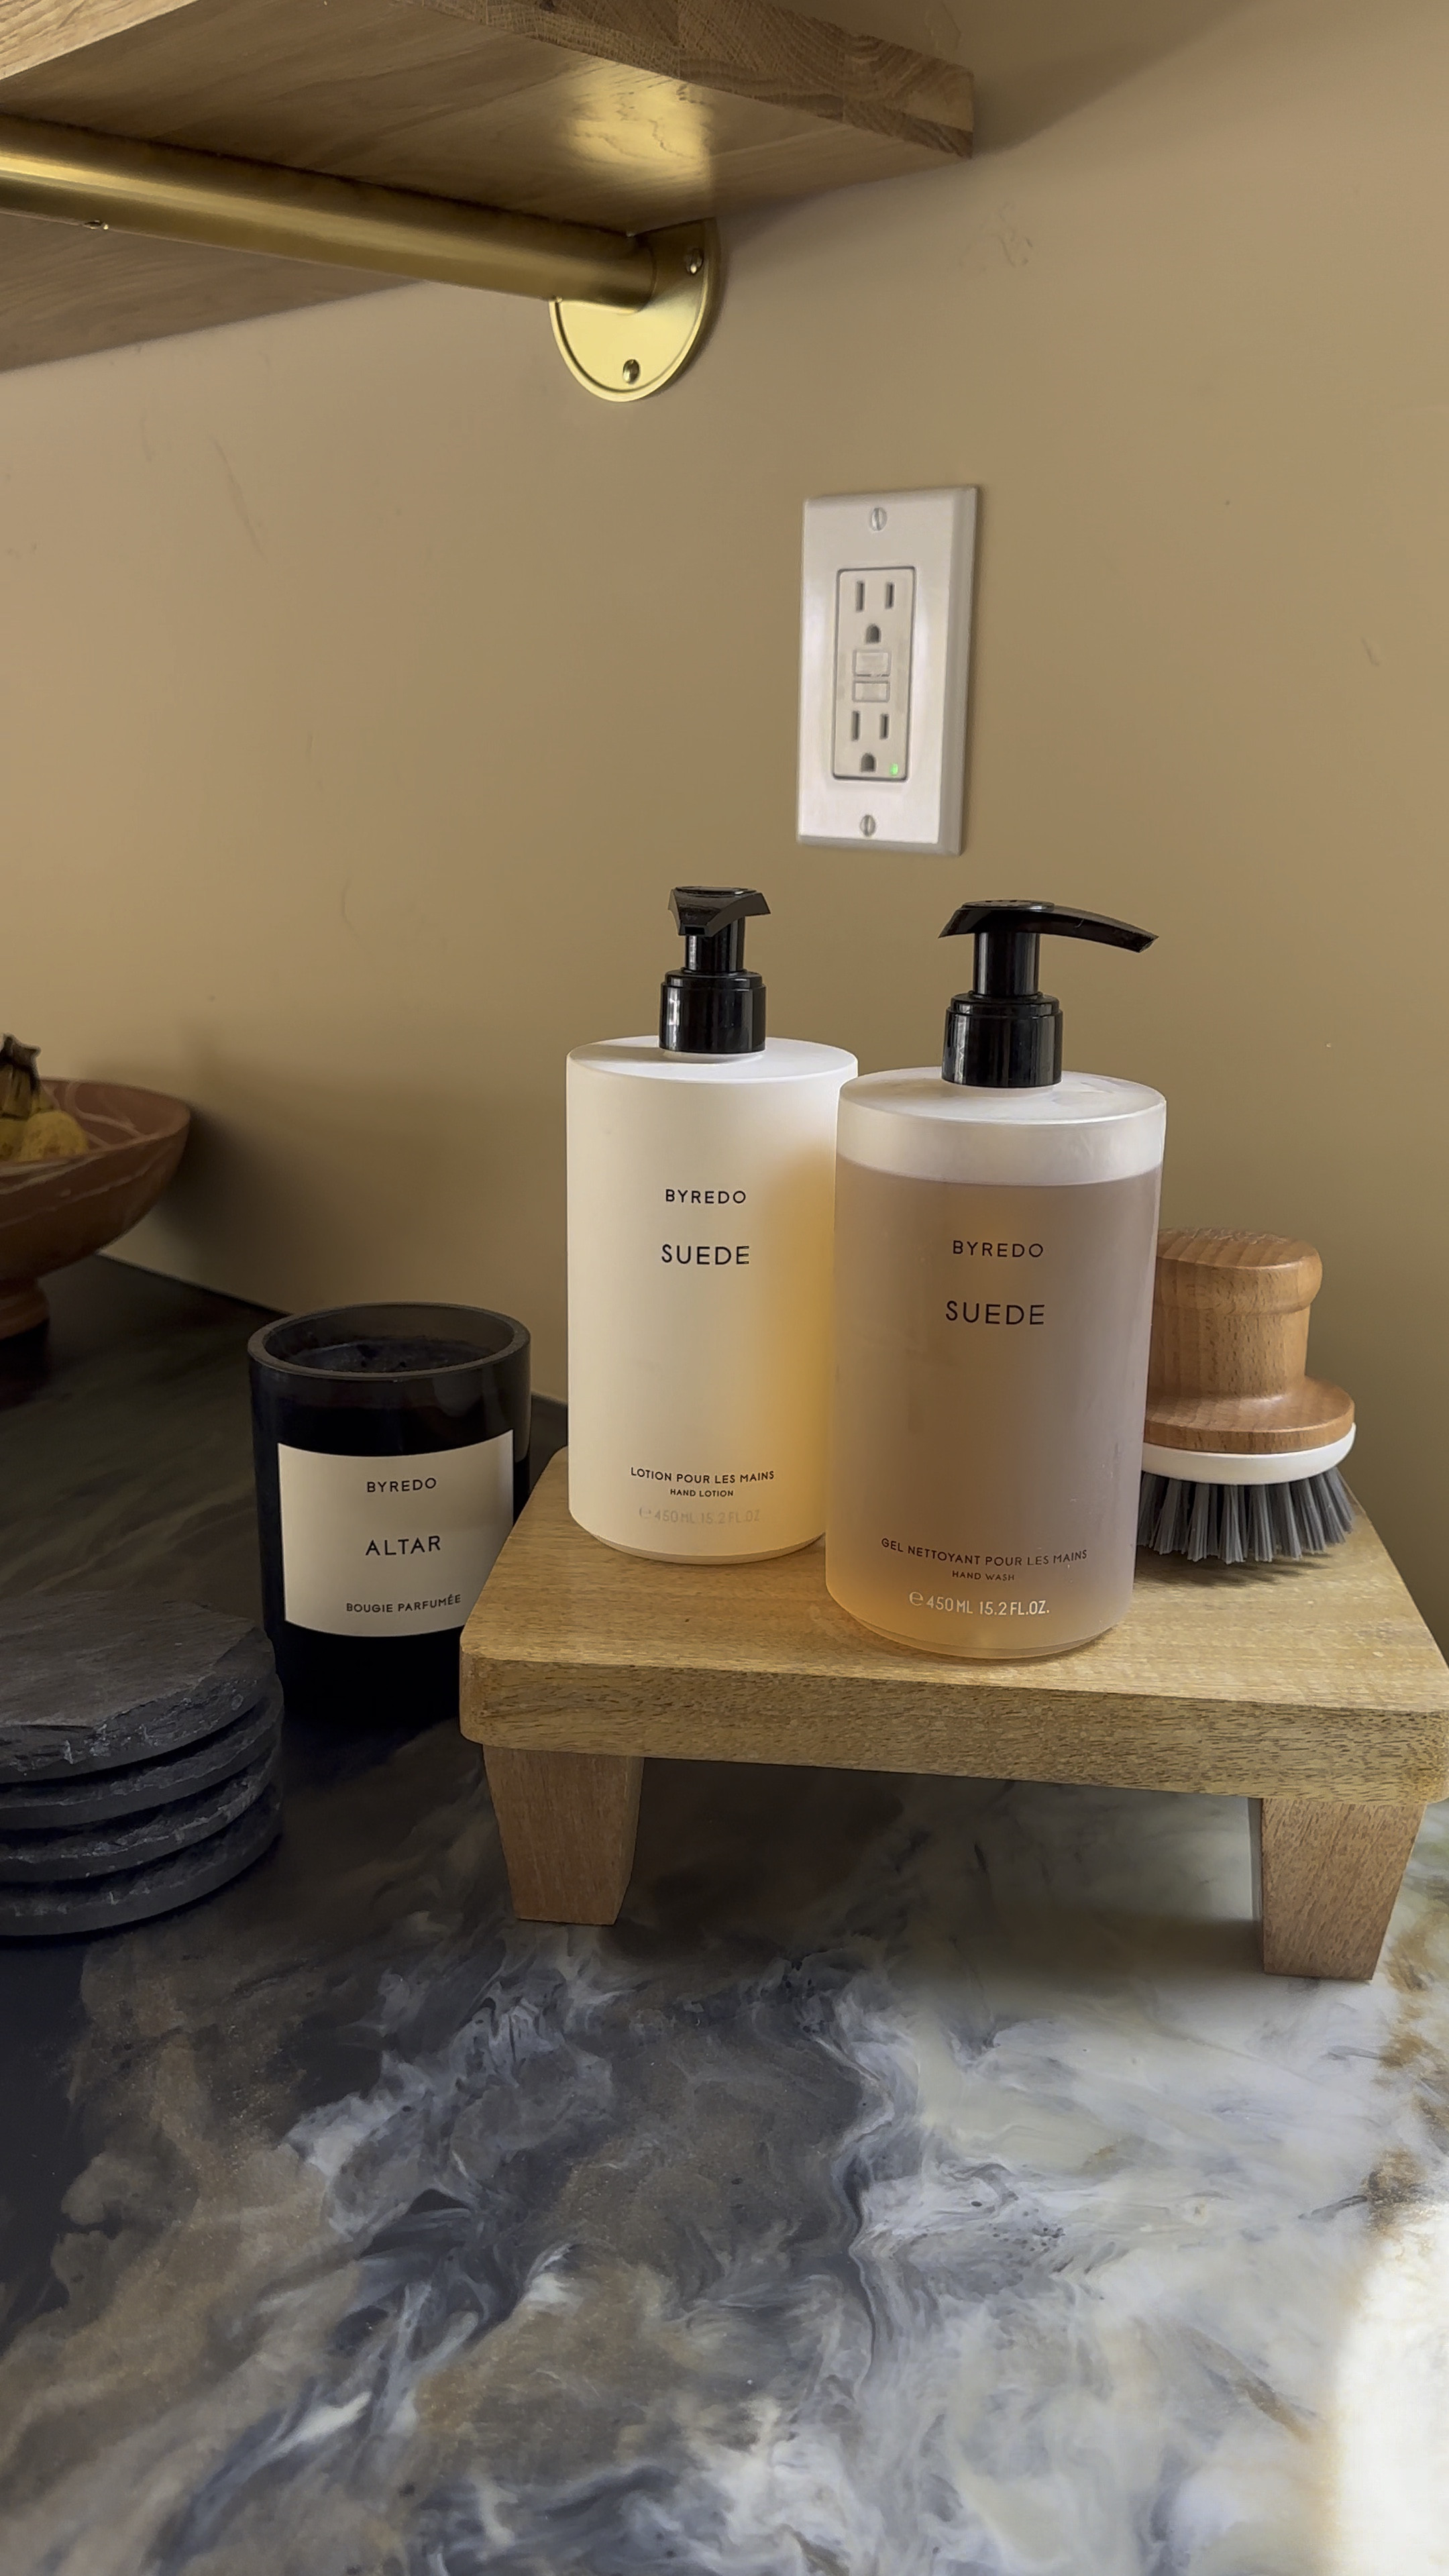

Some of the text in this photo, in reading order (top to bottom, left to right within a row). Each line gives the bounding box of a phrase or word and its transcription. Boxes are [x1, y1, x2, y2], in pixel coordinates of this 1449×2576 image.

[665, 1188, 747, 1204] BYREDO
[661, 1243, 750, 1265] SUEDE
[953, 1240, 1044, 1258] BYREDO
[945, 1300, 1045, 1326] SUEDE
[631, 1466, 775, 1484] LOTION POUR LES MAINS
[366, 1477, 437, 1493] BYREDO
[669, 1488, 696, 1497] HAND
[365, 1535, 441, 1556] ALTAR
[881, 1538, 1087, 1566] GEL NETTOYANT POUR LES MAINS
[952, 1570, 1015, 1582] HAND WASH
[346, 1593, 461, 1613] BOUGIE PARFUMÉE
